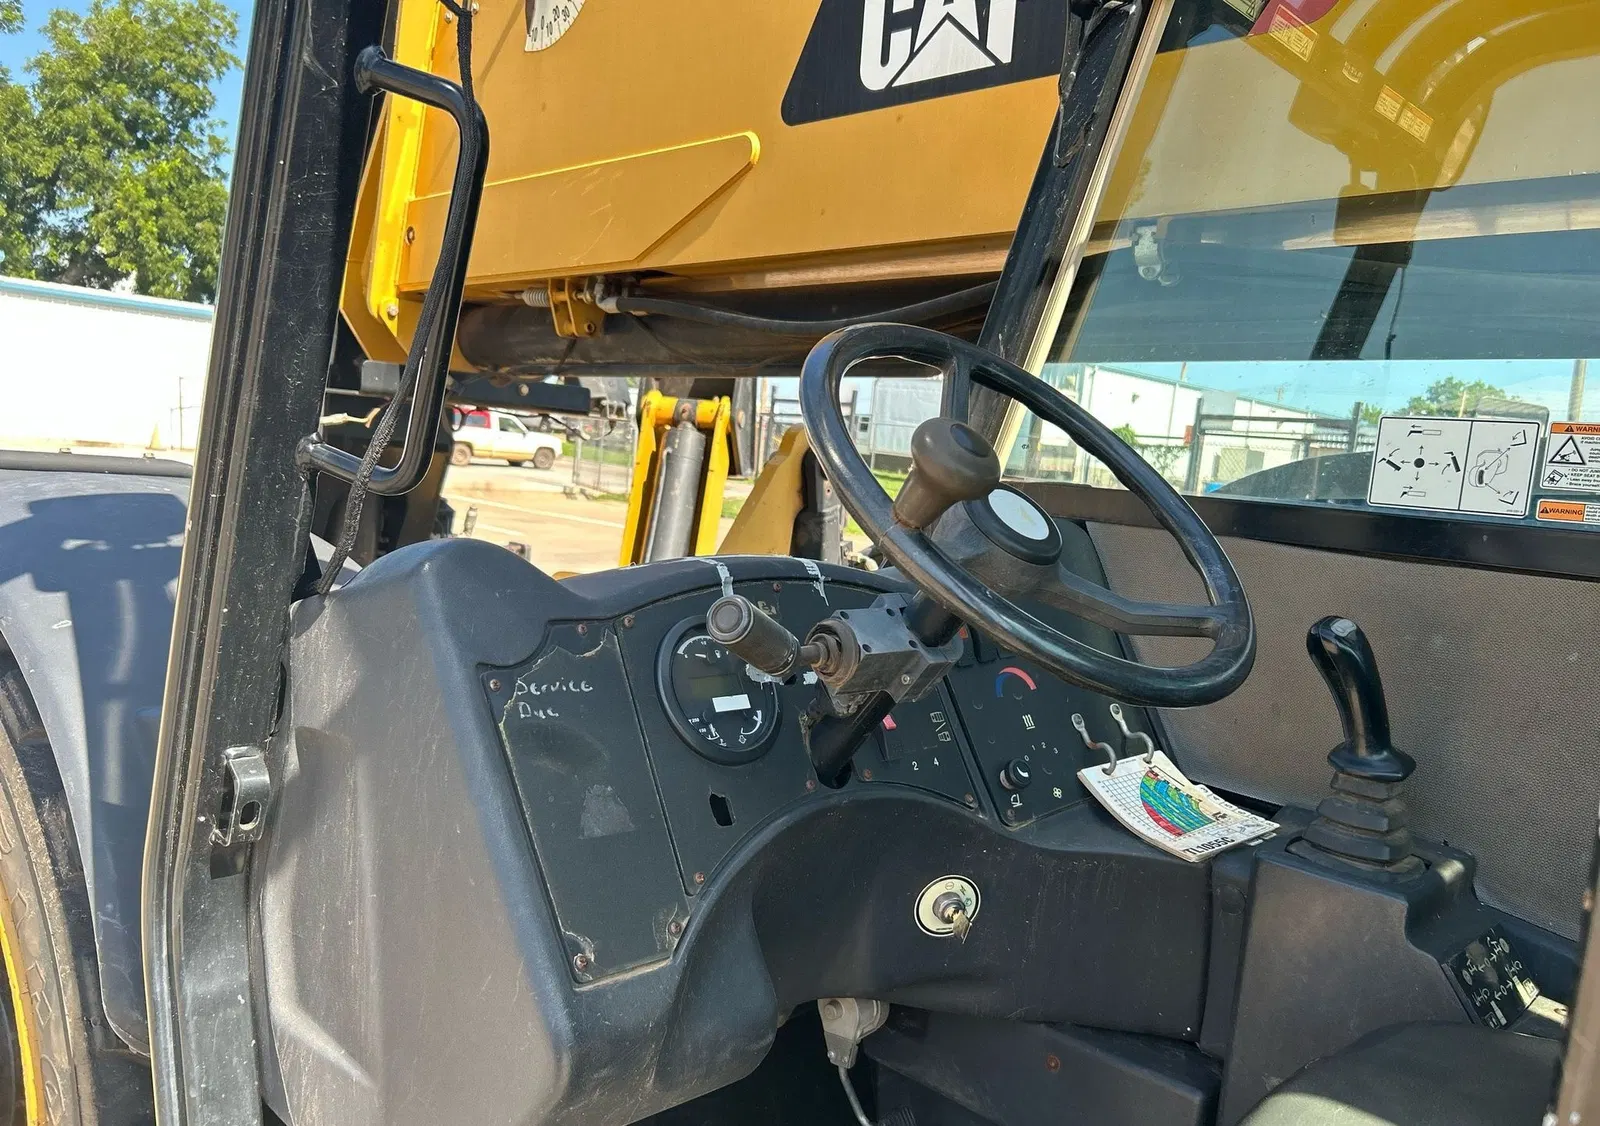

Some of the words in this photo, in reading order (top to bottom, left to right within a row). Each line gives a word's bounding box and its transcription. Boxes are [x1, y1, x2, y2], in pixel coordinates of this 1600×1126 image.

[546, 21, 553, 37] 10
[553, 5, 560, 22] 20
[561, 5, 570, 22] 30
[1549, 507, 1583, 516] WARNING
[516, 677, 593, 695] Service
[518, 701, 559, 719] Due
[1041, 741, 1046, 749] 2
[912, 761, 919, 770] 2
[934, 757, 939, 766] 4
[1184, 837, 1236, 854] TL1055C
